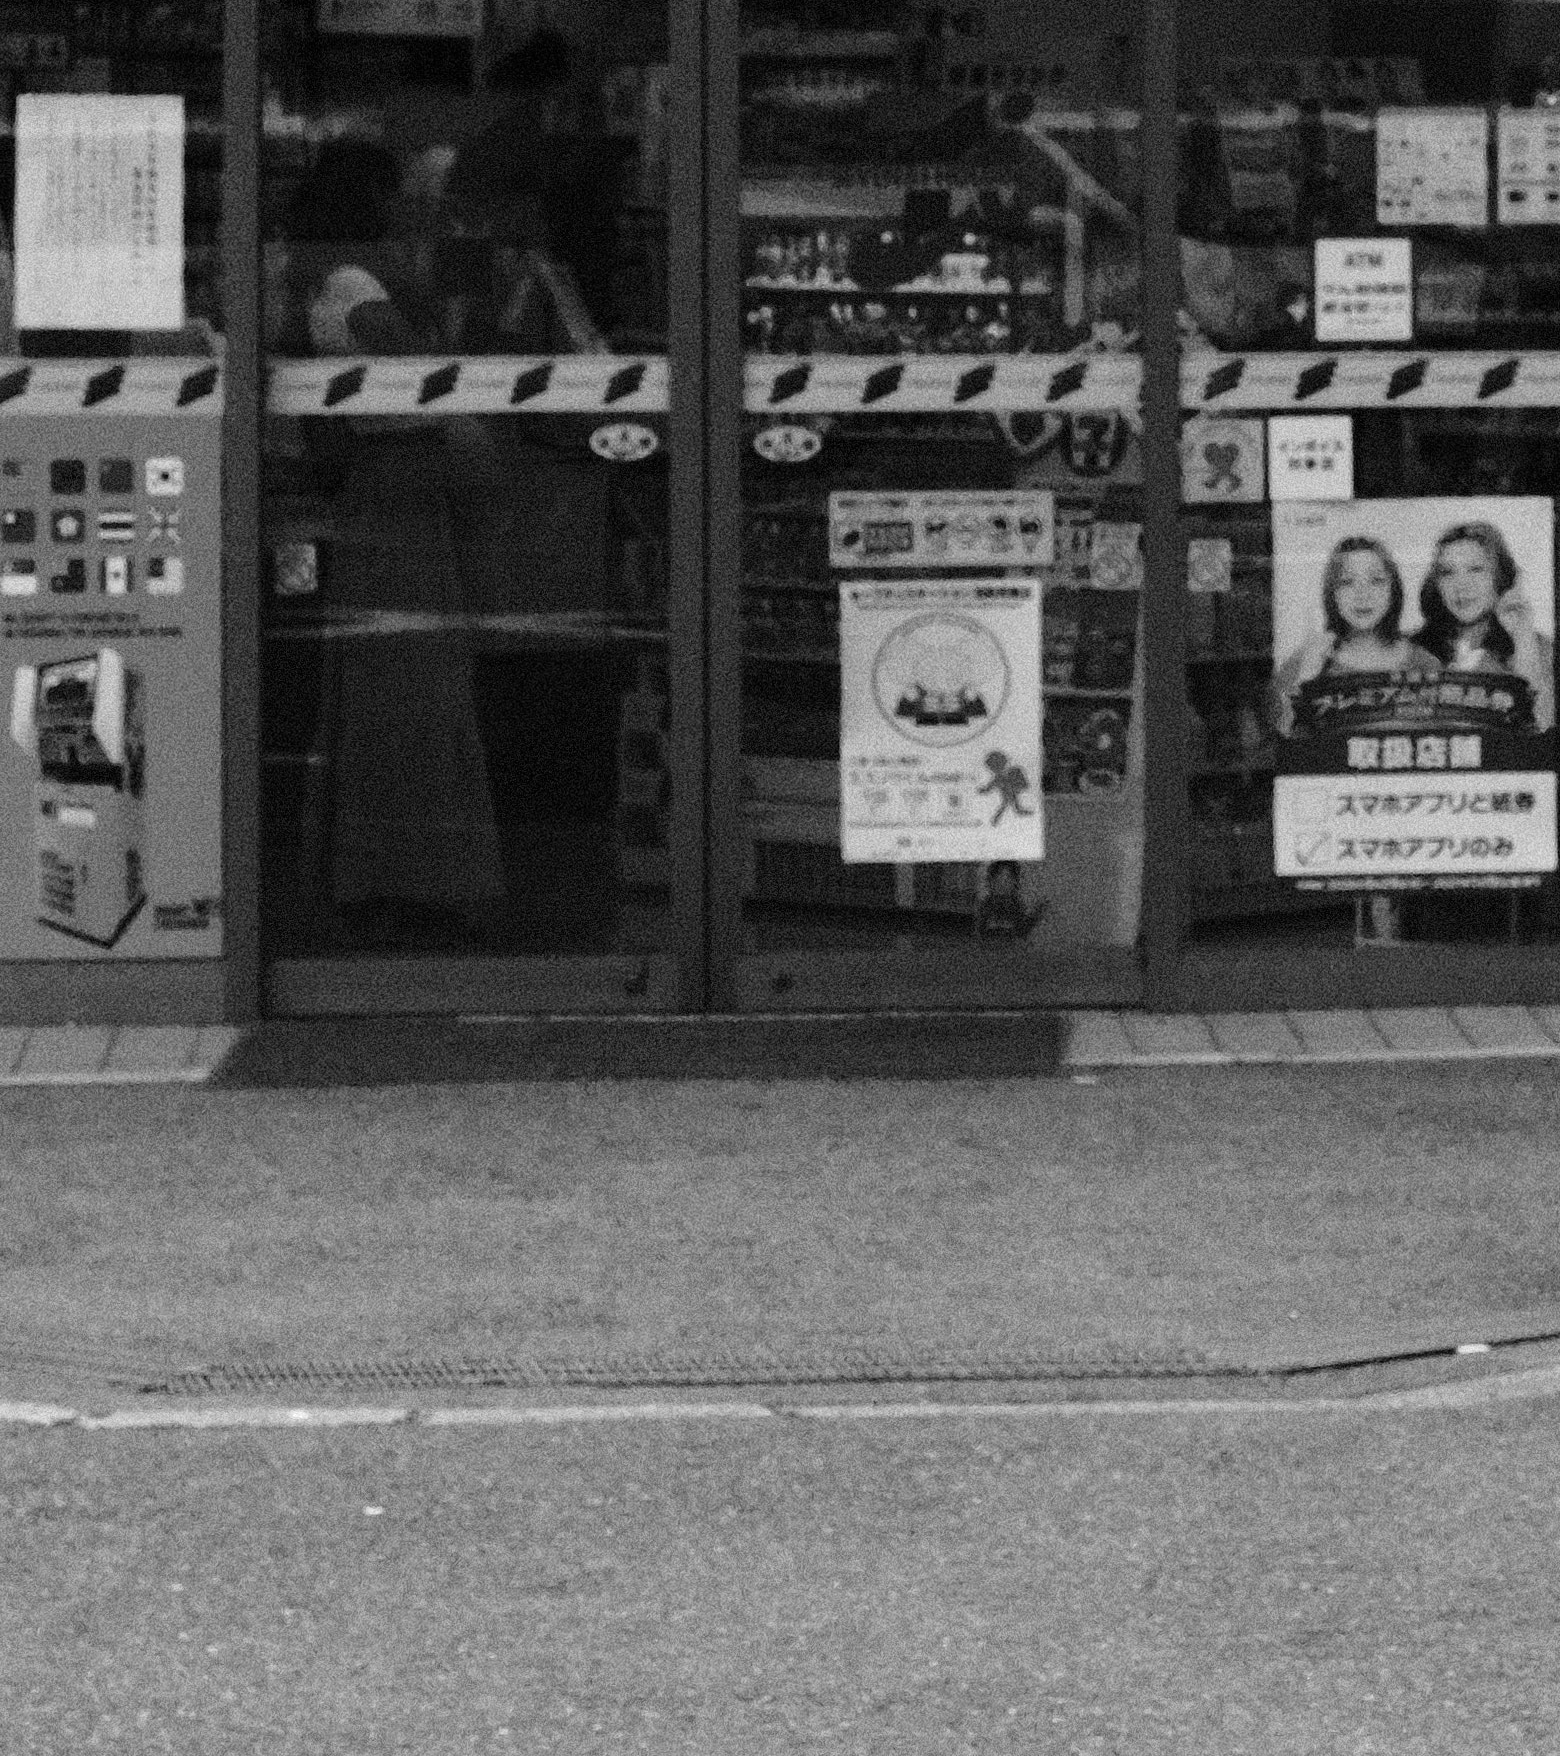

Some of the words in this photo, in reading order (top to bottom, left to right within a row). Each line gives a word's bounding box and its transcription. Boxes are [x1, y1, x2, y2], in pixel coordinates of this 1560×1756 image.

[1335, 837, 1515, 861] スマホアプリのみ
